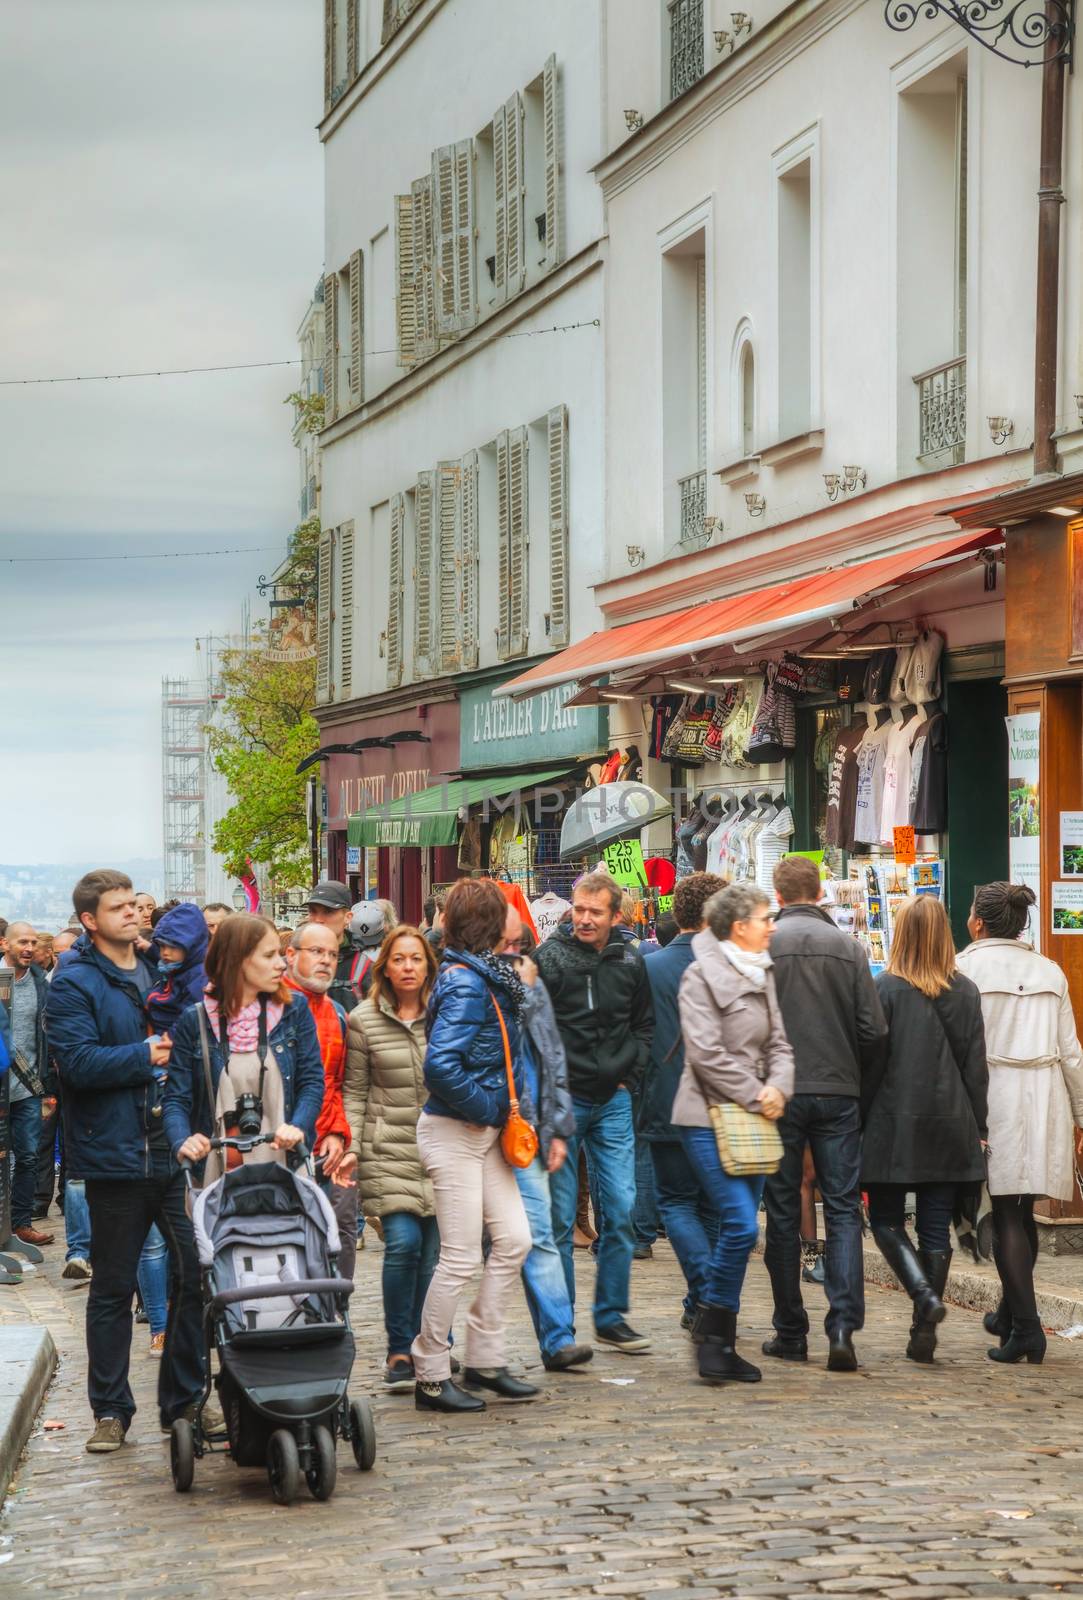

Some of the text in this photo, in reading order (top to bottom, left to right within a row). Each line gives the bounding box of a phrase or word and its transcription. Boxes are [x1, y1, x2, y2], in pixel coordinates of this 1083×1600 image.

[473, 698, 533, 743] L'ATELIER
[340, 779, 353, 820] AU
[357, 775, 386, 813] PETIT
